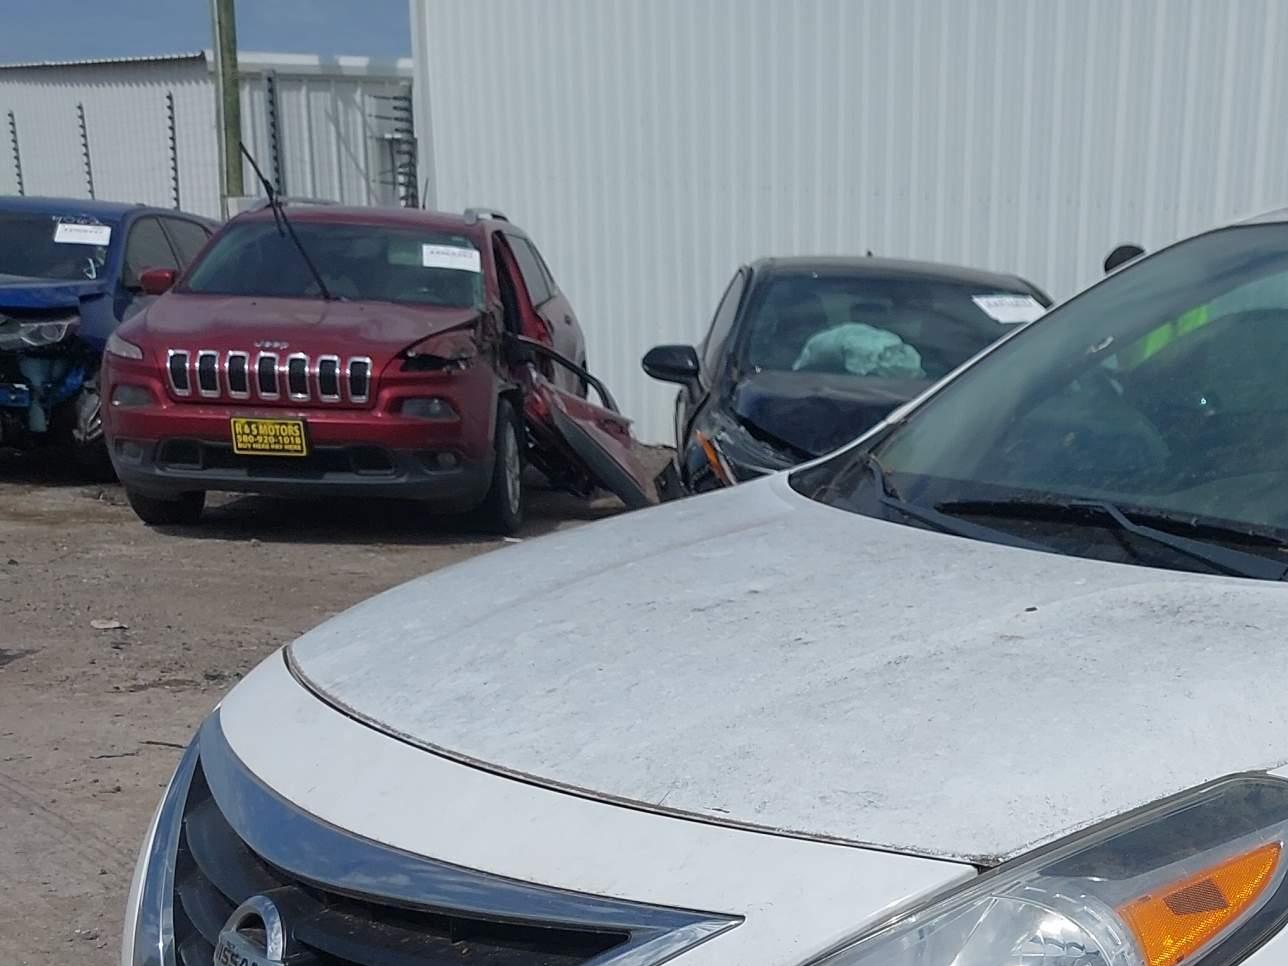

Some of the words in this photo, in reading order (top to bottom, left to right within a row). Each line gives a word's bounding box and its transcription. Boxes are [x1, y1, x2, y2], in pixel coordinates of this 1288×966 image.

[253, 340, 289, 350] Jeep
[251, 423, 258, 435] S
[258, 424, 300, 436] MOTORS
